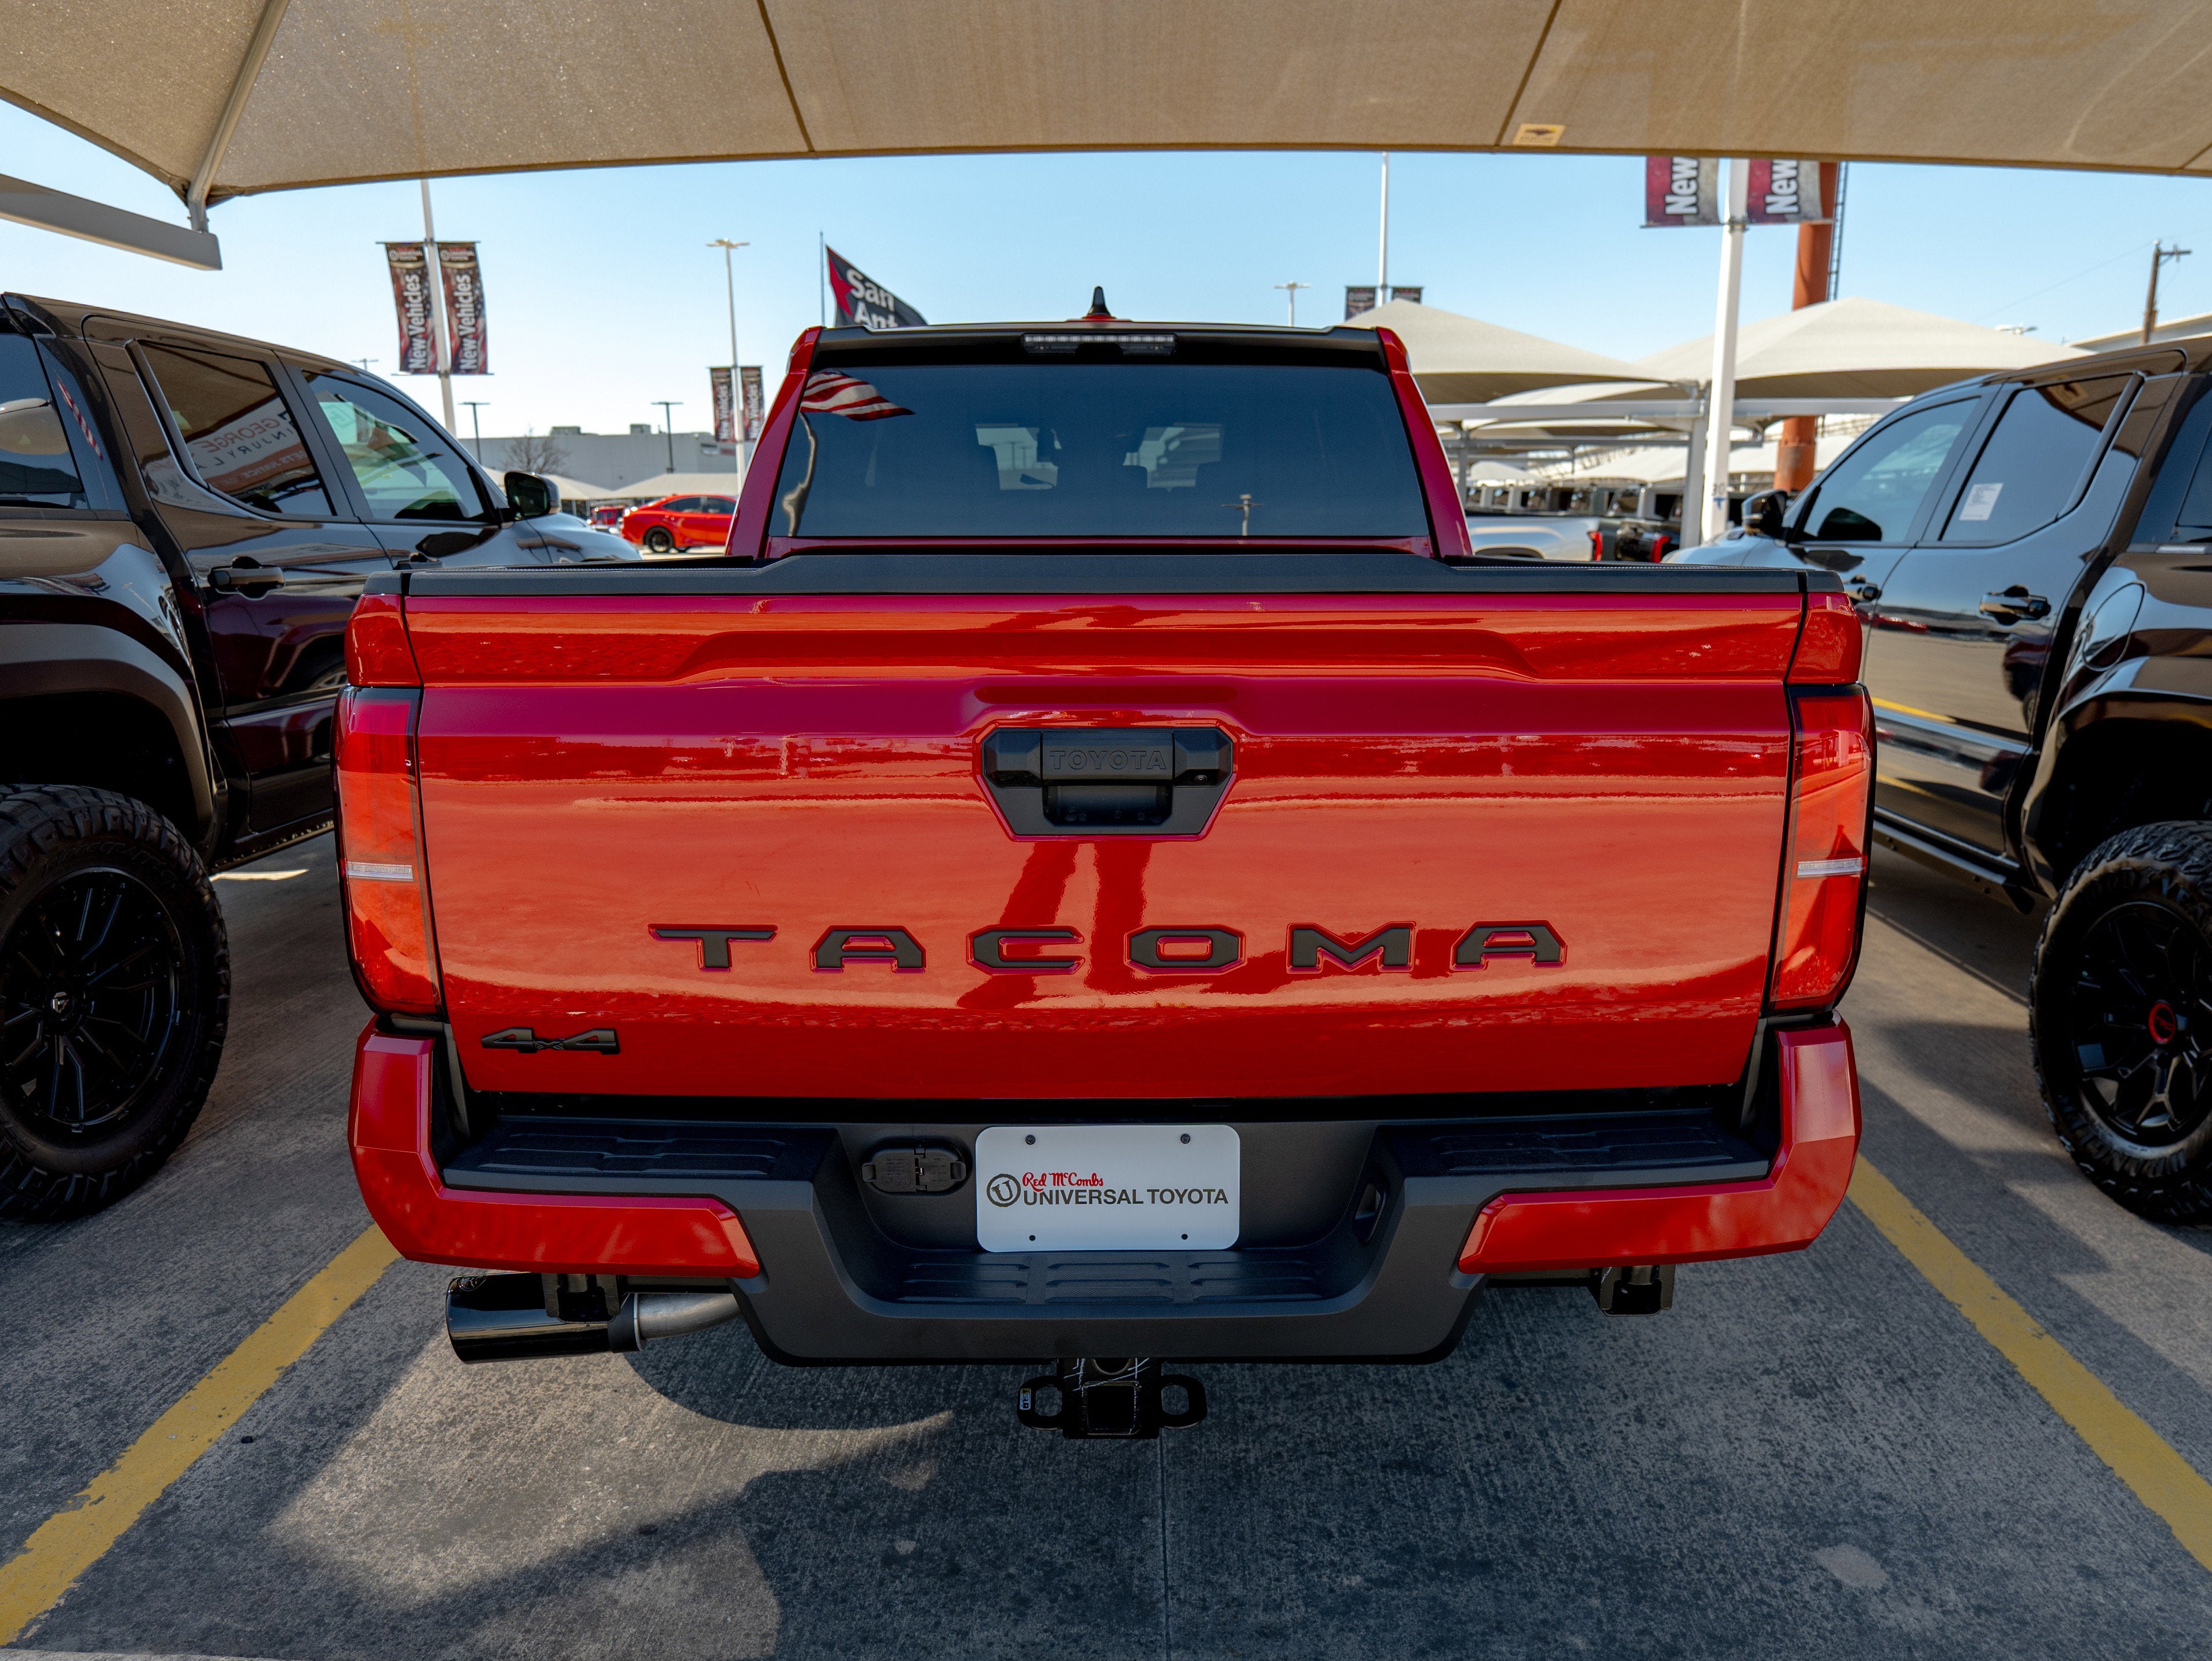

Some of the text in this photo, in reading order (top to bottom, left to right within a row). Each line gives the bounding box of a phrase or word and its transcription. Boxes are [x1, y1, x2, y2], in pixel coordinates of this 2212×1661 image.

[1665, 156, 1698, 214] New
[1765, 159, 1800, 214] New
[403, 273, 426, 336] Vehicles
[453, 273, 476, 336] Vehicles
[846, 268, 895, 312] San
[408, 338, 427, 369] New
[459, 338, 479, 370] New
[1050, 750, 1166, 770] TOYOTA
[649, 920, 1567, 974] TACOMA
[1022, 1172, 1104, 1192] Red McCombs
[1024, 1189, 1229, 1206] UNIVERSAL TOYOTA
